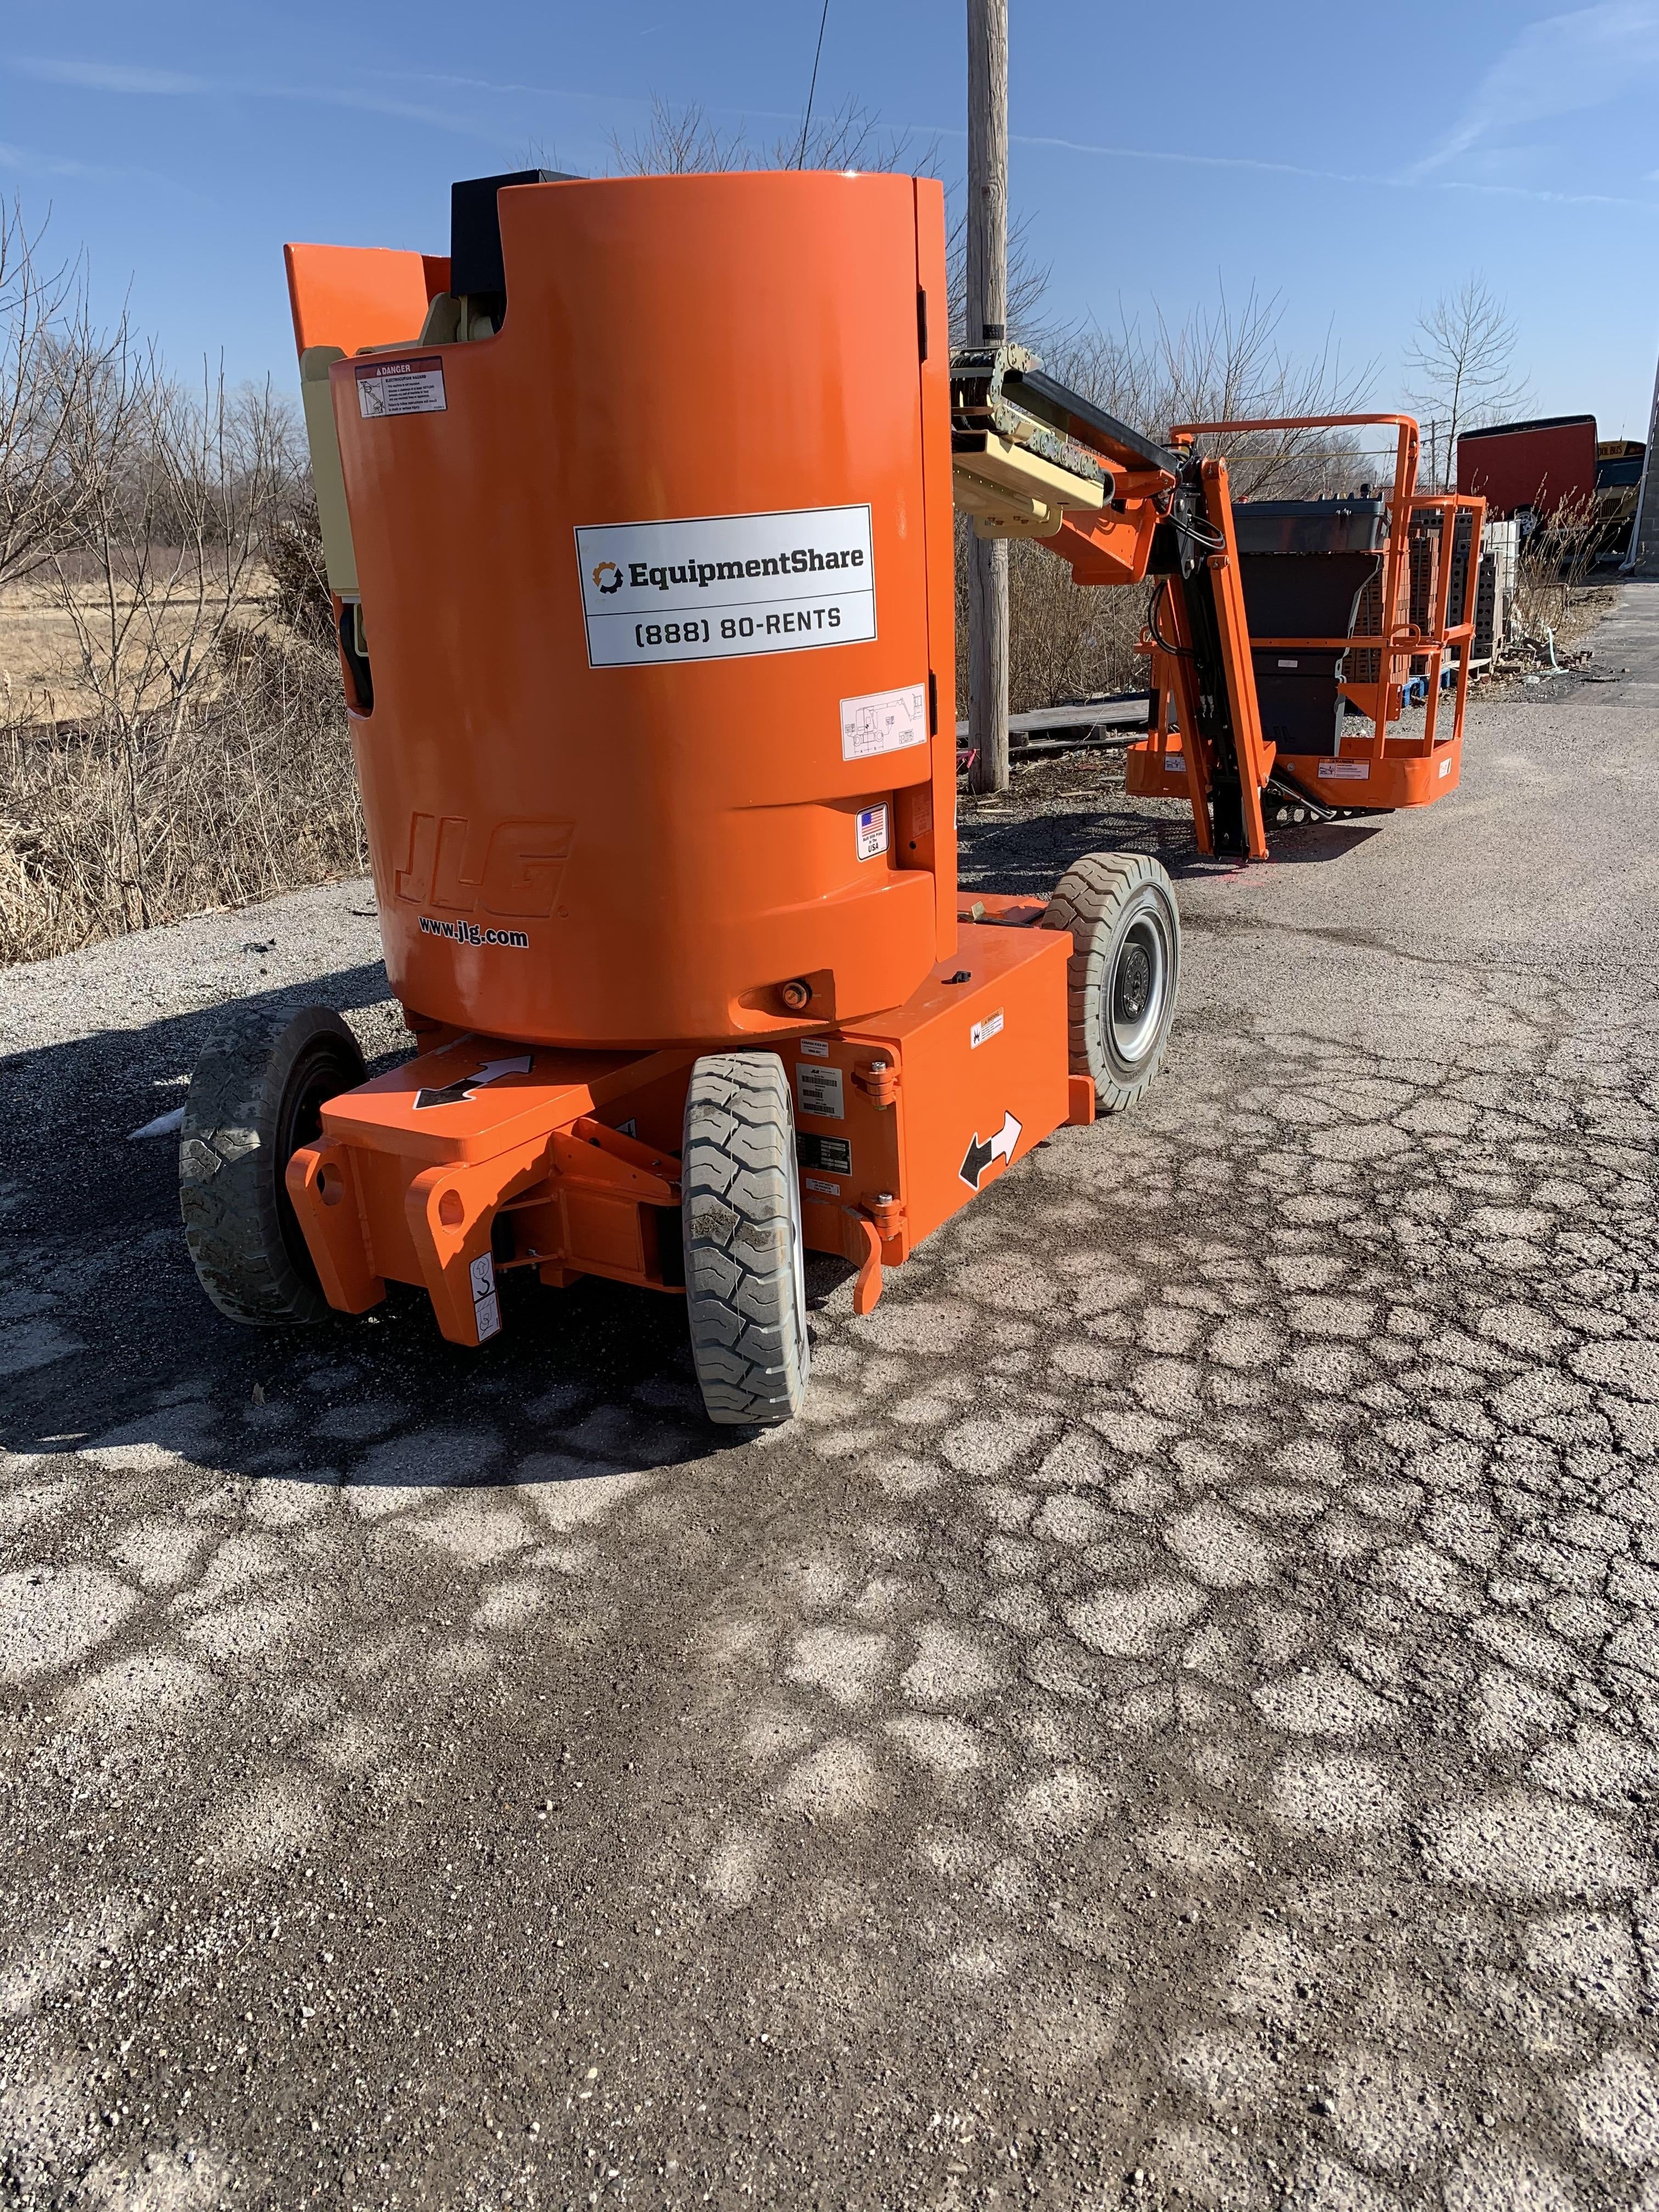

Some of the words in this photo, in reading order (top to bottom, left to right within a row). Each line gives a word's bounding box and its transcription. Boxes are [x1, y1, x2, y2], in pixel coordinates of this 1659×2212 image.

[382, 365, 410, 375] DANGER
[1610, 445, 1622, 455] BUS
[628, 549, 864, 590] EquipmentShare
[635, 619, 709, 647] (888)
[721, 607, 840, 640] 80-RENTS
[868, 842, 878, 853] USA
[395, 811, 576, 919] JLG
[418, 916, 529, 947] www.jlg.com
